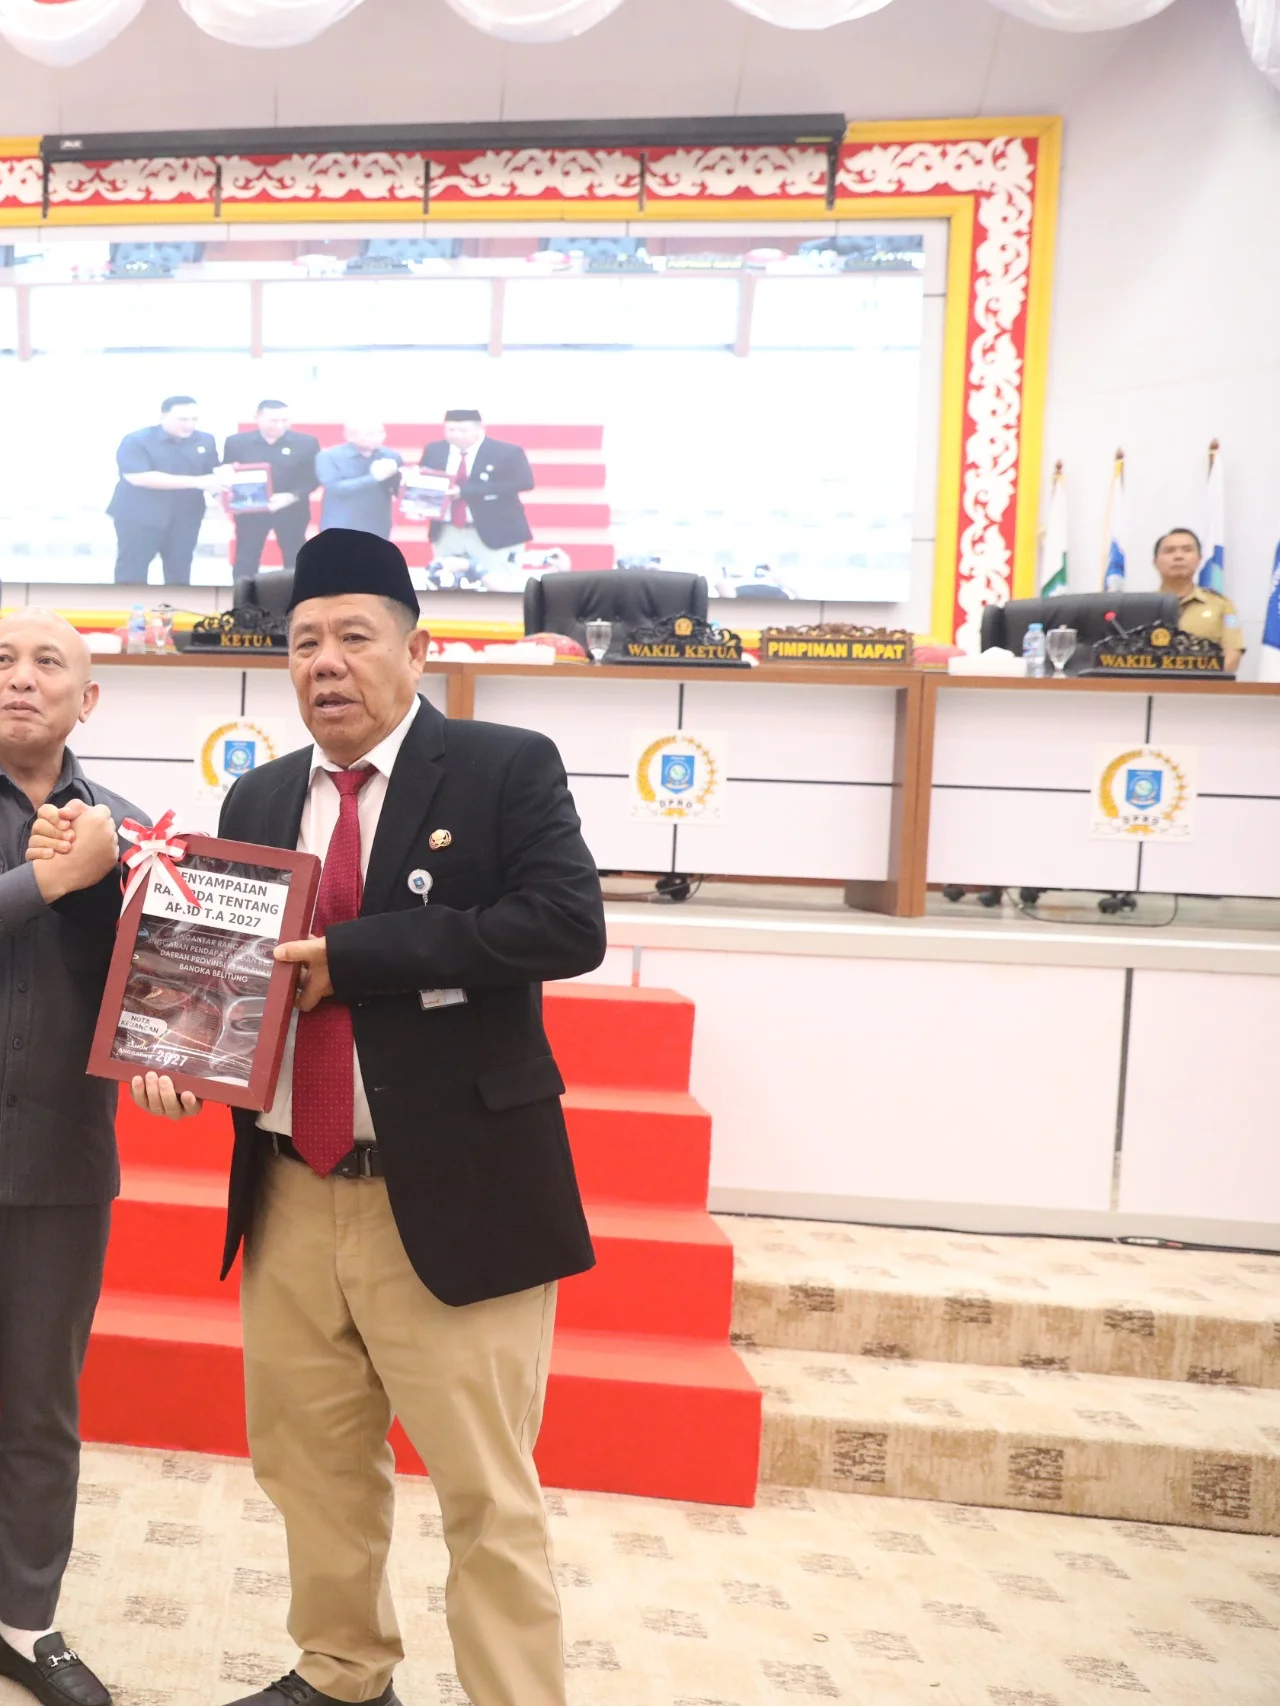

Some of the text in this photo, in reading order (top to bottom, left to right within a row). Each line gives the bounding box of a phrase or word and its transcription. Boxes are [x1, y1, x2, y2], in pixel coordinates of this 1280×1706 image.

[220, 633, 273, 647] KETUA
[627, 643, 738, 659] WAKIL KETUA
[768, 641, 905, 660] PIMPINAN RAPAT
[1099, 653, 1221, 670] WAKIL KETUA
[181, 871, 268, 897] ENYAMPAIAN
[218, 894, 280, 915] TENTANG
[204, 908, 224, 921] T.A
[228, 912, 261, 928] 2027
[160, 949, 190, 961] DAERAH
[191, 955, 226, 968] PROVINSI
[179, 963, 248, 983] BANGKA BELITUNG
[155, 1049, 189, 1067] 2027
